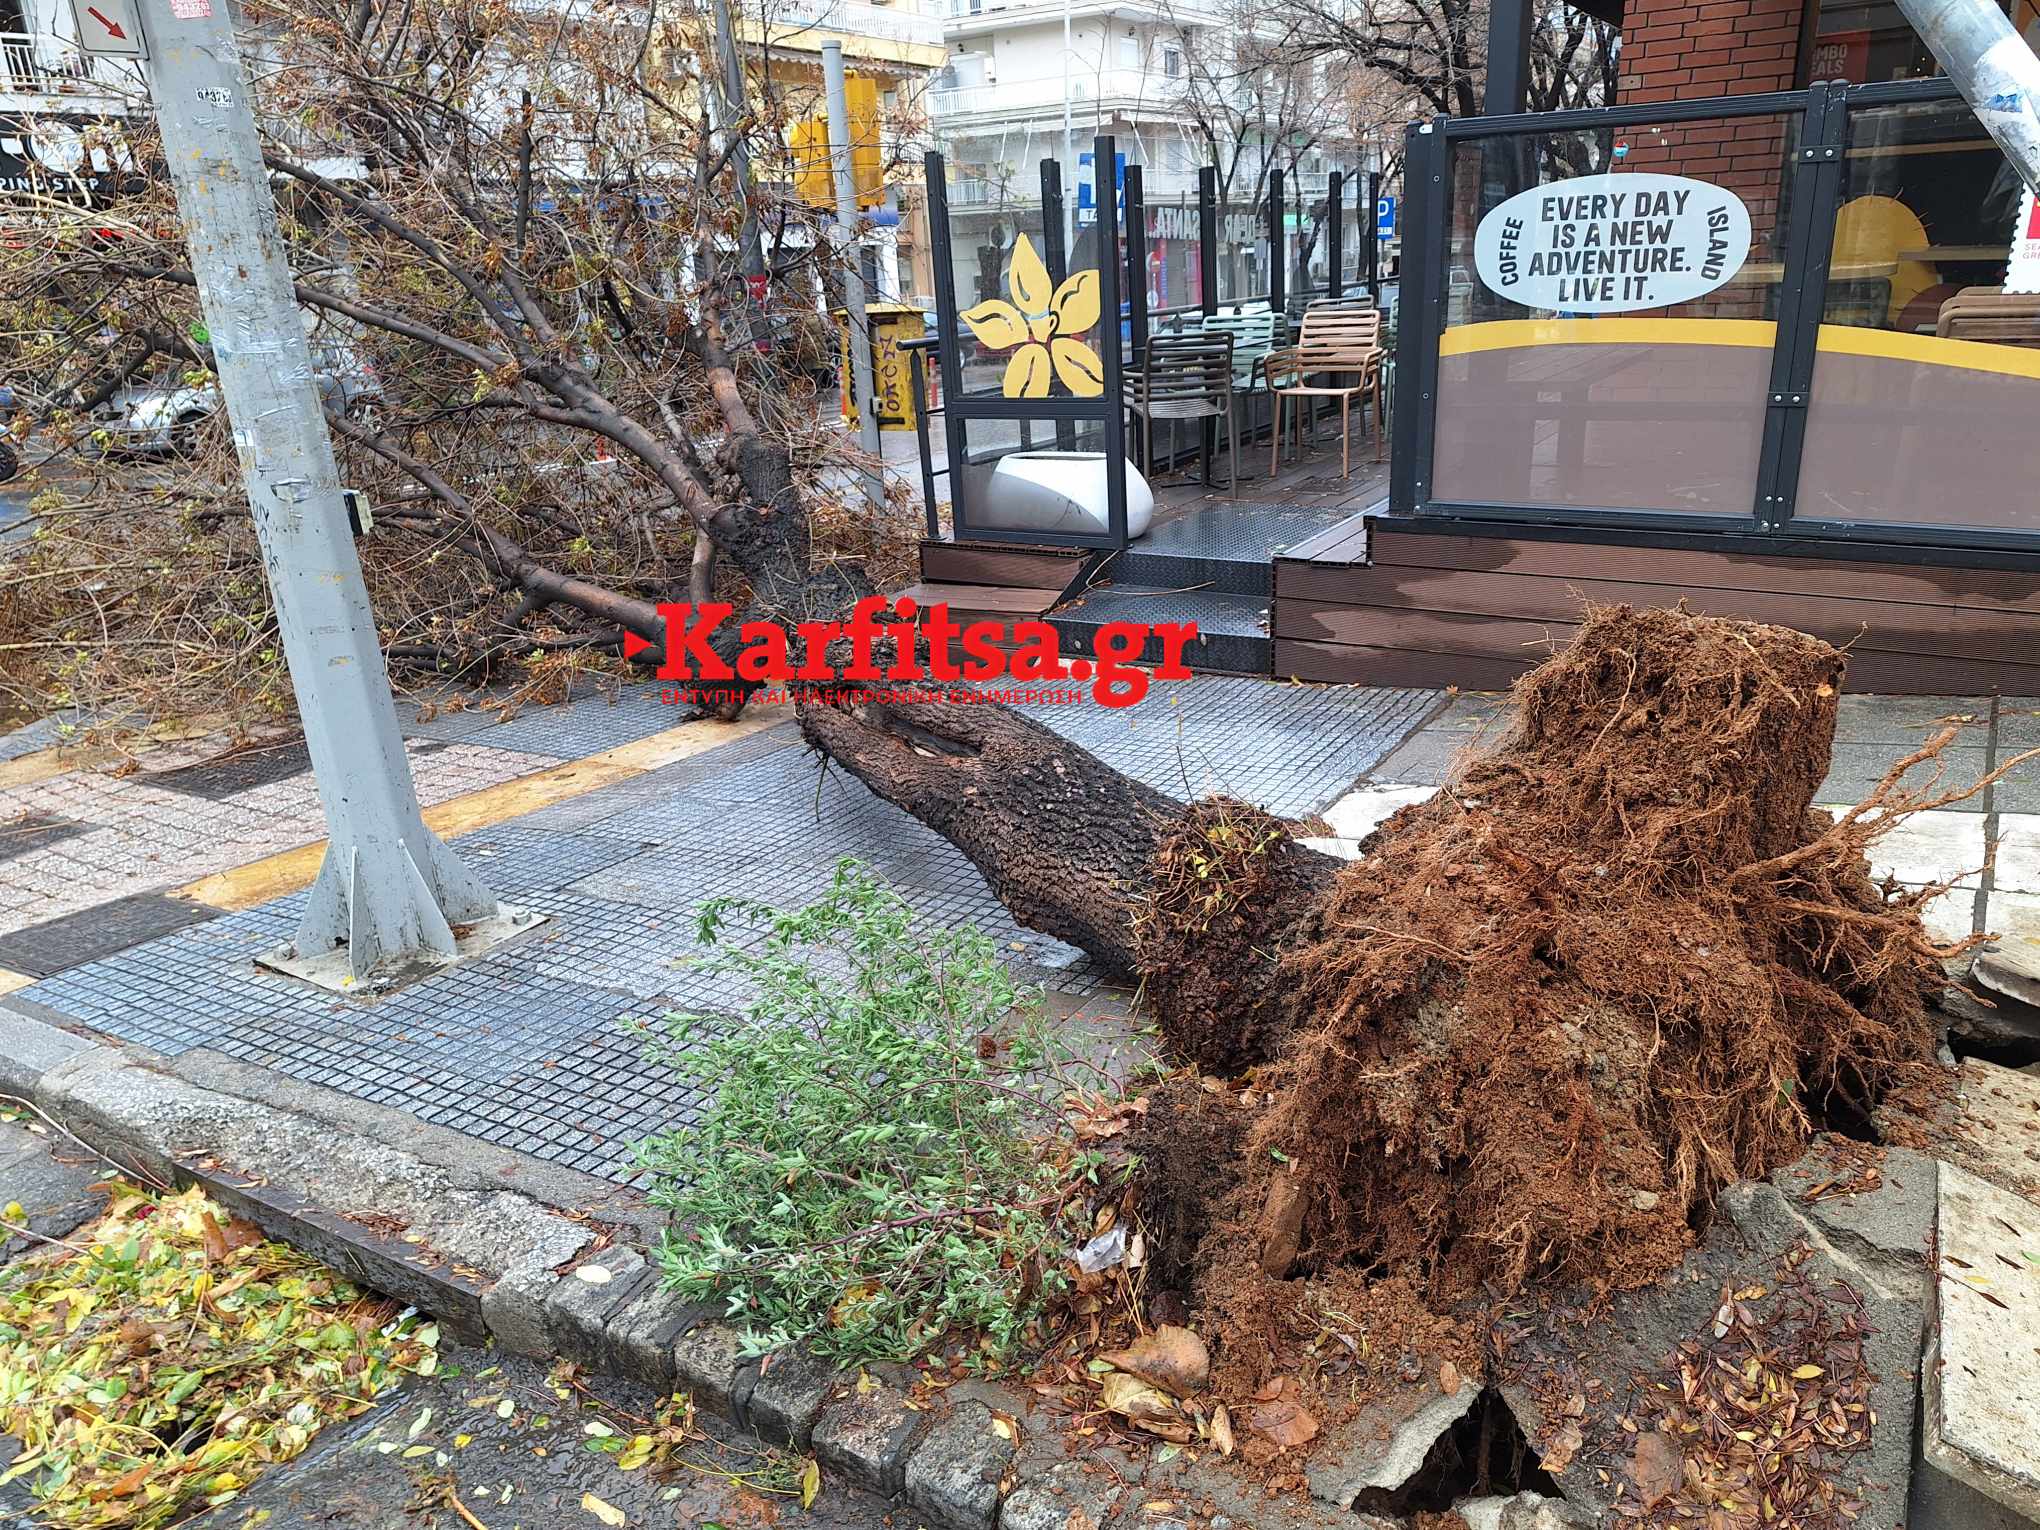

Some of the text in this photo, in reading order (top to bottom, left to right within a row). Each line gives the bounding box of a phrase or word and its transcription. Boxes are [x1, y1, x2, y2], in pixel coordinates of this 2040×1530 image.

[1541, 189, 1691, 222] EVERY DAY
[1552, 219, 1674, 249] IS A NEW
[1700, 205, 1729, 281] ISLAND
[1499, 216, 1524, 287] COFFEE
[1528, 246, 1692, 277] ADVENTURE.
[1558, 275, 1654, 303] LIVE IT.
